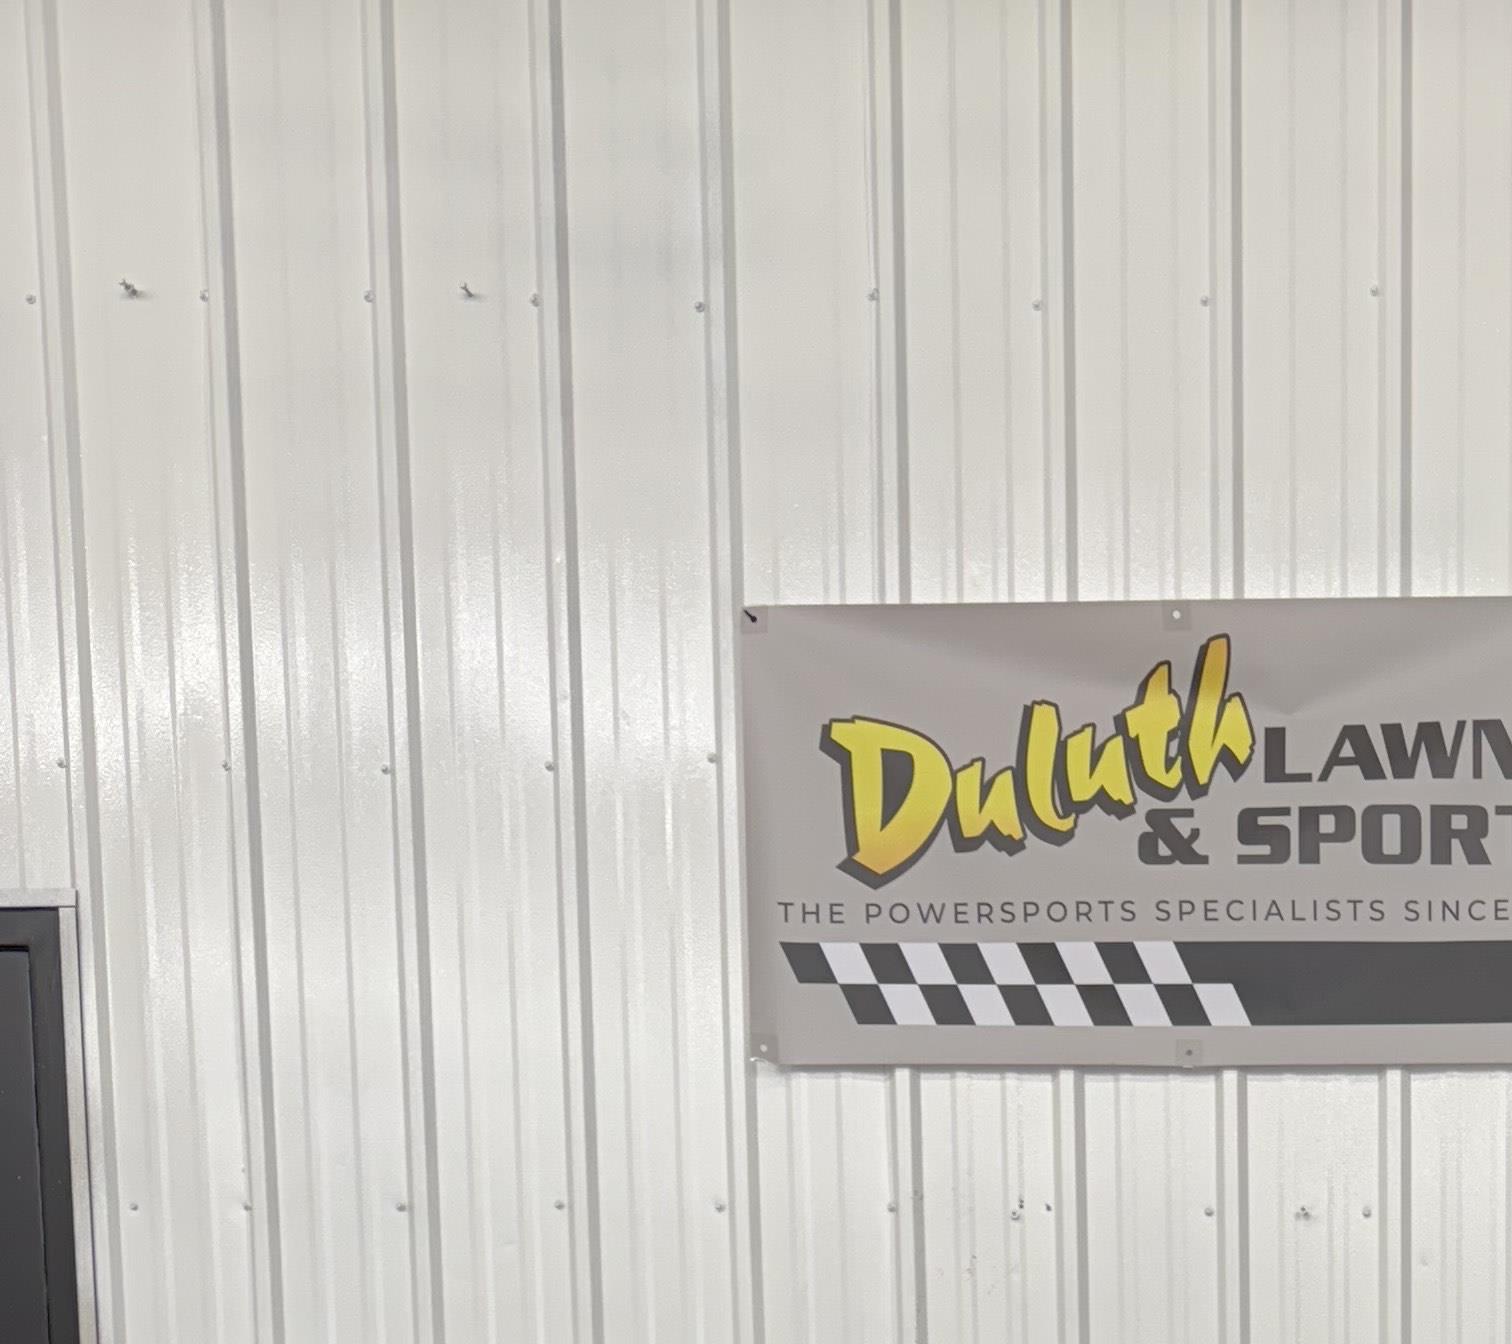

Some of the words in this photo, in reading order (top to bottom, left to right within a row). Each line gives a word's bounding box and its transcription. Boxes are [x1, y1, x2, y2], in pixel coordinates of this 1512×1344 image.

[819, 633, 1256, 888] Duluth
[1137, 806, 1209, 865] &
[778, 902, 844, 923] THE
[866, 901, 1136, 923] POWERSPORTS
[1156, 900, 1384, 921] SPECIALISTS
[1405, 900, 1509, 921] SINCE
